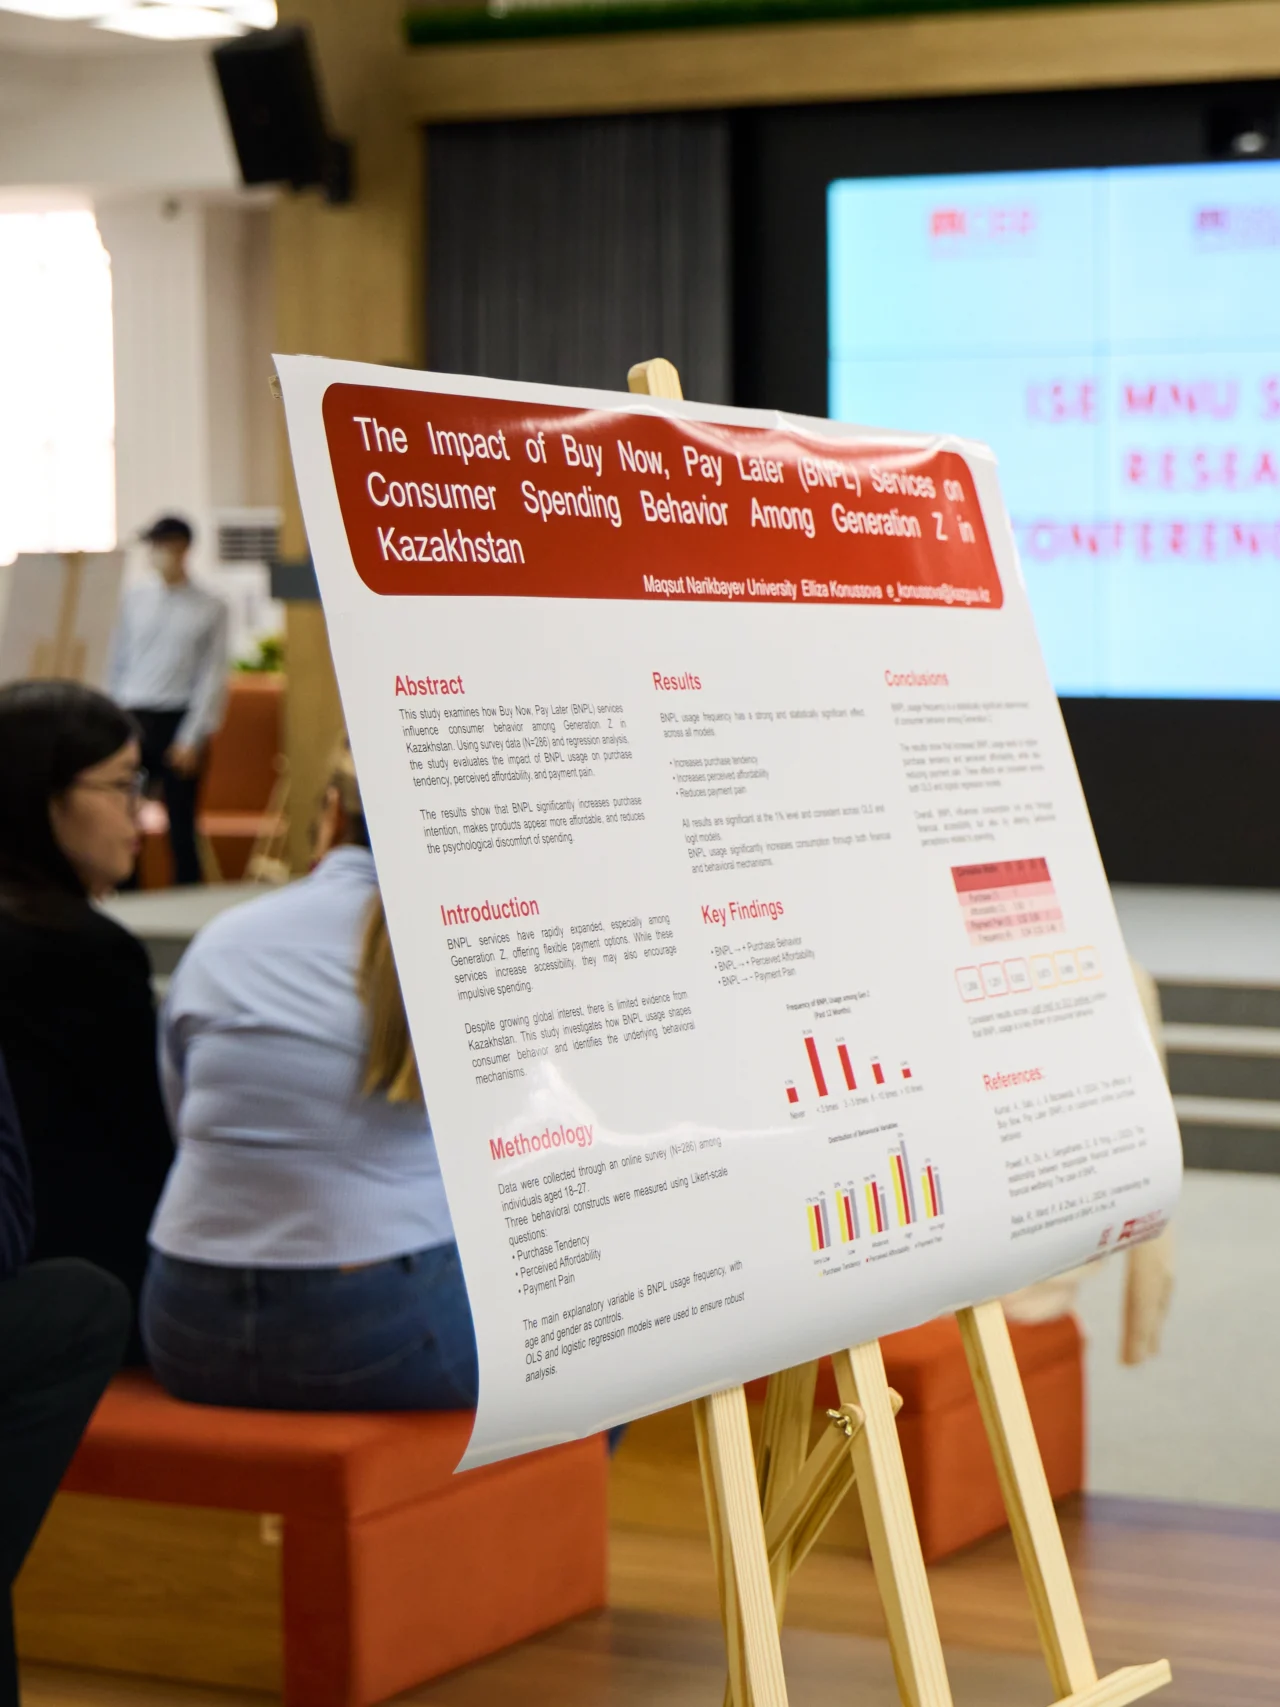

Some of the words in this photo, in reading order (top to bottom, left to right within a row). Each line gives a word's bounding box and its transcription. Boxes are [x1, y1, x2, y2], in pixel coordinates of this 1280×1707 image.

[353, 416, 408, 453] The
[427, 421, 510, 465] Impact
[525, 432, 547, 463] of
[561, 434, 602, 477] Buy
[617, 440, 670, 480] Now,
[683, 445, 722, 486] Pay
[736, 453, 784, 483] Later
[798, 457, 861, 497] (BNPL)
[869, 464, 936, 499] Services
[943, 478, 965, 502] on
[367, 472, 496, 510] Consumer
[521, 480, 622, 528] Spending
[639, 490, 729, 526] Behavior
[750, 497, 816, 539] Among
[831, 503, 922, 539] Generation
[932, 511, 948, 541] Z
[957, 516, 975, 544] in
[377, 526, 525, 564] Kazakhstan
[643, 574, 685, 597] Maqsut
[686, 576, 745, 599] Narikbayev
[747, 578, 797, 601] University
[395, 675, 465, 696] Abstract
[652, 671, 702, 690] Results
[884, 669, 949, 687] Conclusions
[399, 708, 417, 719] This
[419, 707, 440, 720] study
[444, 706, 479, 718] examines
[481, 706, 496, 716] how
[499, 705, 512, 718] Buy
[535, 704, 548, 717] Pay
[550, 704, 567, 714] Later
[571, 703, 595, 715] (BNPL)
[597, 704, 623, 713] services
[456, 739, 479, 752] Using
[480, 740, 503, 751] survey
[505, 738, 521, 748] data
[522, 736, 550, 749] (N=286)
[552, 735, 565, 746] and
[566, 736, 600, 748] regression
[409, 759, 423, 770] the
[427, 757, 448, 770] study
[453, 756, 489, 767] evaluates
[492, 754, 504, 765] the
[507, 753, 531, 766] impact
[534, 752, 541, 763] of
[544, 751, 564, 762] BNPL
[567, 752, 588, 763] usage
[591, 752, 600, 760] on
[603, 749, 632, 761] purchase
[453, 771, 490, 786] perceived
[534, 768, 547, 779] and
[548, 767, 577, 780] payment
[427, 843, 440, 854] the
[442, 837, 494, 854] psychological
[495, 834, 532, 847] discomfort
[533, 833, 540, 844] of
[440, 896, 540, 926] Introduction
[701, 904, 726, 927] Key
[728, 899, 784, 921] Findings
[451, 951, 495, 966] Generation
[512, 945, 540, 958] offering
[543, 941, 567, 953] flexible
[572, 937, 600, 952] payment
[633, 931, 652, 942] While
[655, 929, 673, 939] these
[457, 985, 495, 1001] impulsive
[489, 1124, 594, 1160] Methodology
[498, 1182, 517, 1194] Data
[520, 1177, 539, 1189] were
[543, 1167, 576, 1184] collected
[578, 1161, 606, 1176] through
[609, 1160, 618, 1169] an
[621, 1154, 642, 1167] online
[644, 1149, 666, 1161] survey
[669, 1140, 696, 1157] (N=286)
[699, 1137, 721, 1149] among
[501, 1193, 542, 1211] individuals
[544, 1187, 562, 1203] aged
[504, 1215, 528, 1228] Three
[531, 1203, 570, 1222] behavioral
[573, 1195, 610, 1212] constructs
[613, 1191, 630, 1202] were
[634, 1180, 667, 1197] measured
[670, 1177, 688, 1188] using
[690, 1166, 728, 1183] Likert-scale
[509, 1228, 547, 1247] questions:
[517, 1244, 553, 1260] Purchase
[555, 1235, 589, 1251] Tendency
[520, 1258, 558, 1278] Perceived
[560, 1248, 600, 1268] Affordability
[523, 1276, 557, 1295] Payment
[558, 1272, 575, 1285] Pain
[523, 1318, 537, 1330] The
[541, 1311, 559, 1325] main
[563, 1300, 603, 1320] explanatory
[607, 1290, 634, 1306] variable
[638, 1289, 644, 1297] is
[647, 1280, 667, 1295] BNPL
[670, 1276, 690, 1289] usage
[693, 1266, 726, 1282] frequency,
[729, 1259, 742, 1271] with
[525, 1336, 538, 1349] age
[541, 1329, 554, 1343] and
[556, 1323, 581, 1341] gender
[583, 1320, 592, 1331] as
[594, 1310, 623, 1327] controls.
[526, 1350, 542, 1364] OLS
[545, 1345, 558, 1359] and
[561, 1338, 586, 1355] logistic
[588, 1328, 625, 1346] regression
[627, 1318, 652, 1334] models
[654, 1314, 670, 1326] were
[673, 1306, 689, 1320] used
[691, 1305, 698, 1315] to
[700, 1299, 722, 1312] ensure
[724, 1291, 744, 1305] robust
[525, 1365, 557, 1382] analysis.
